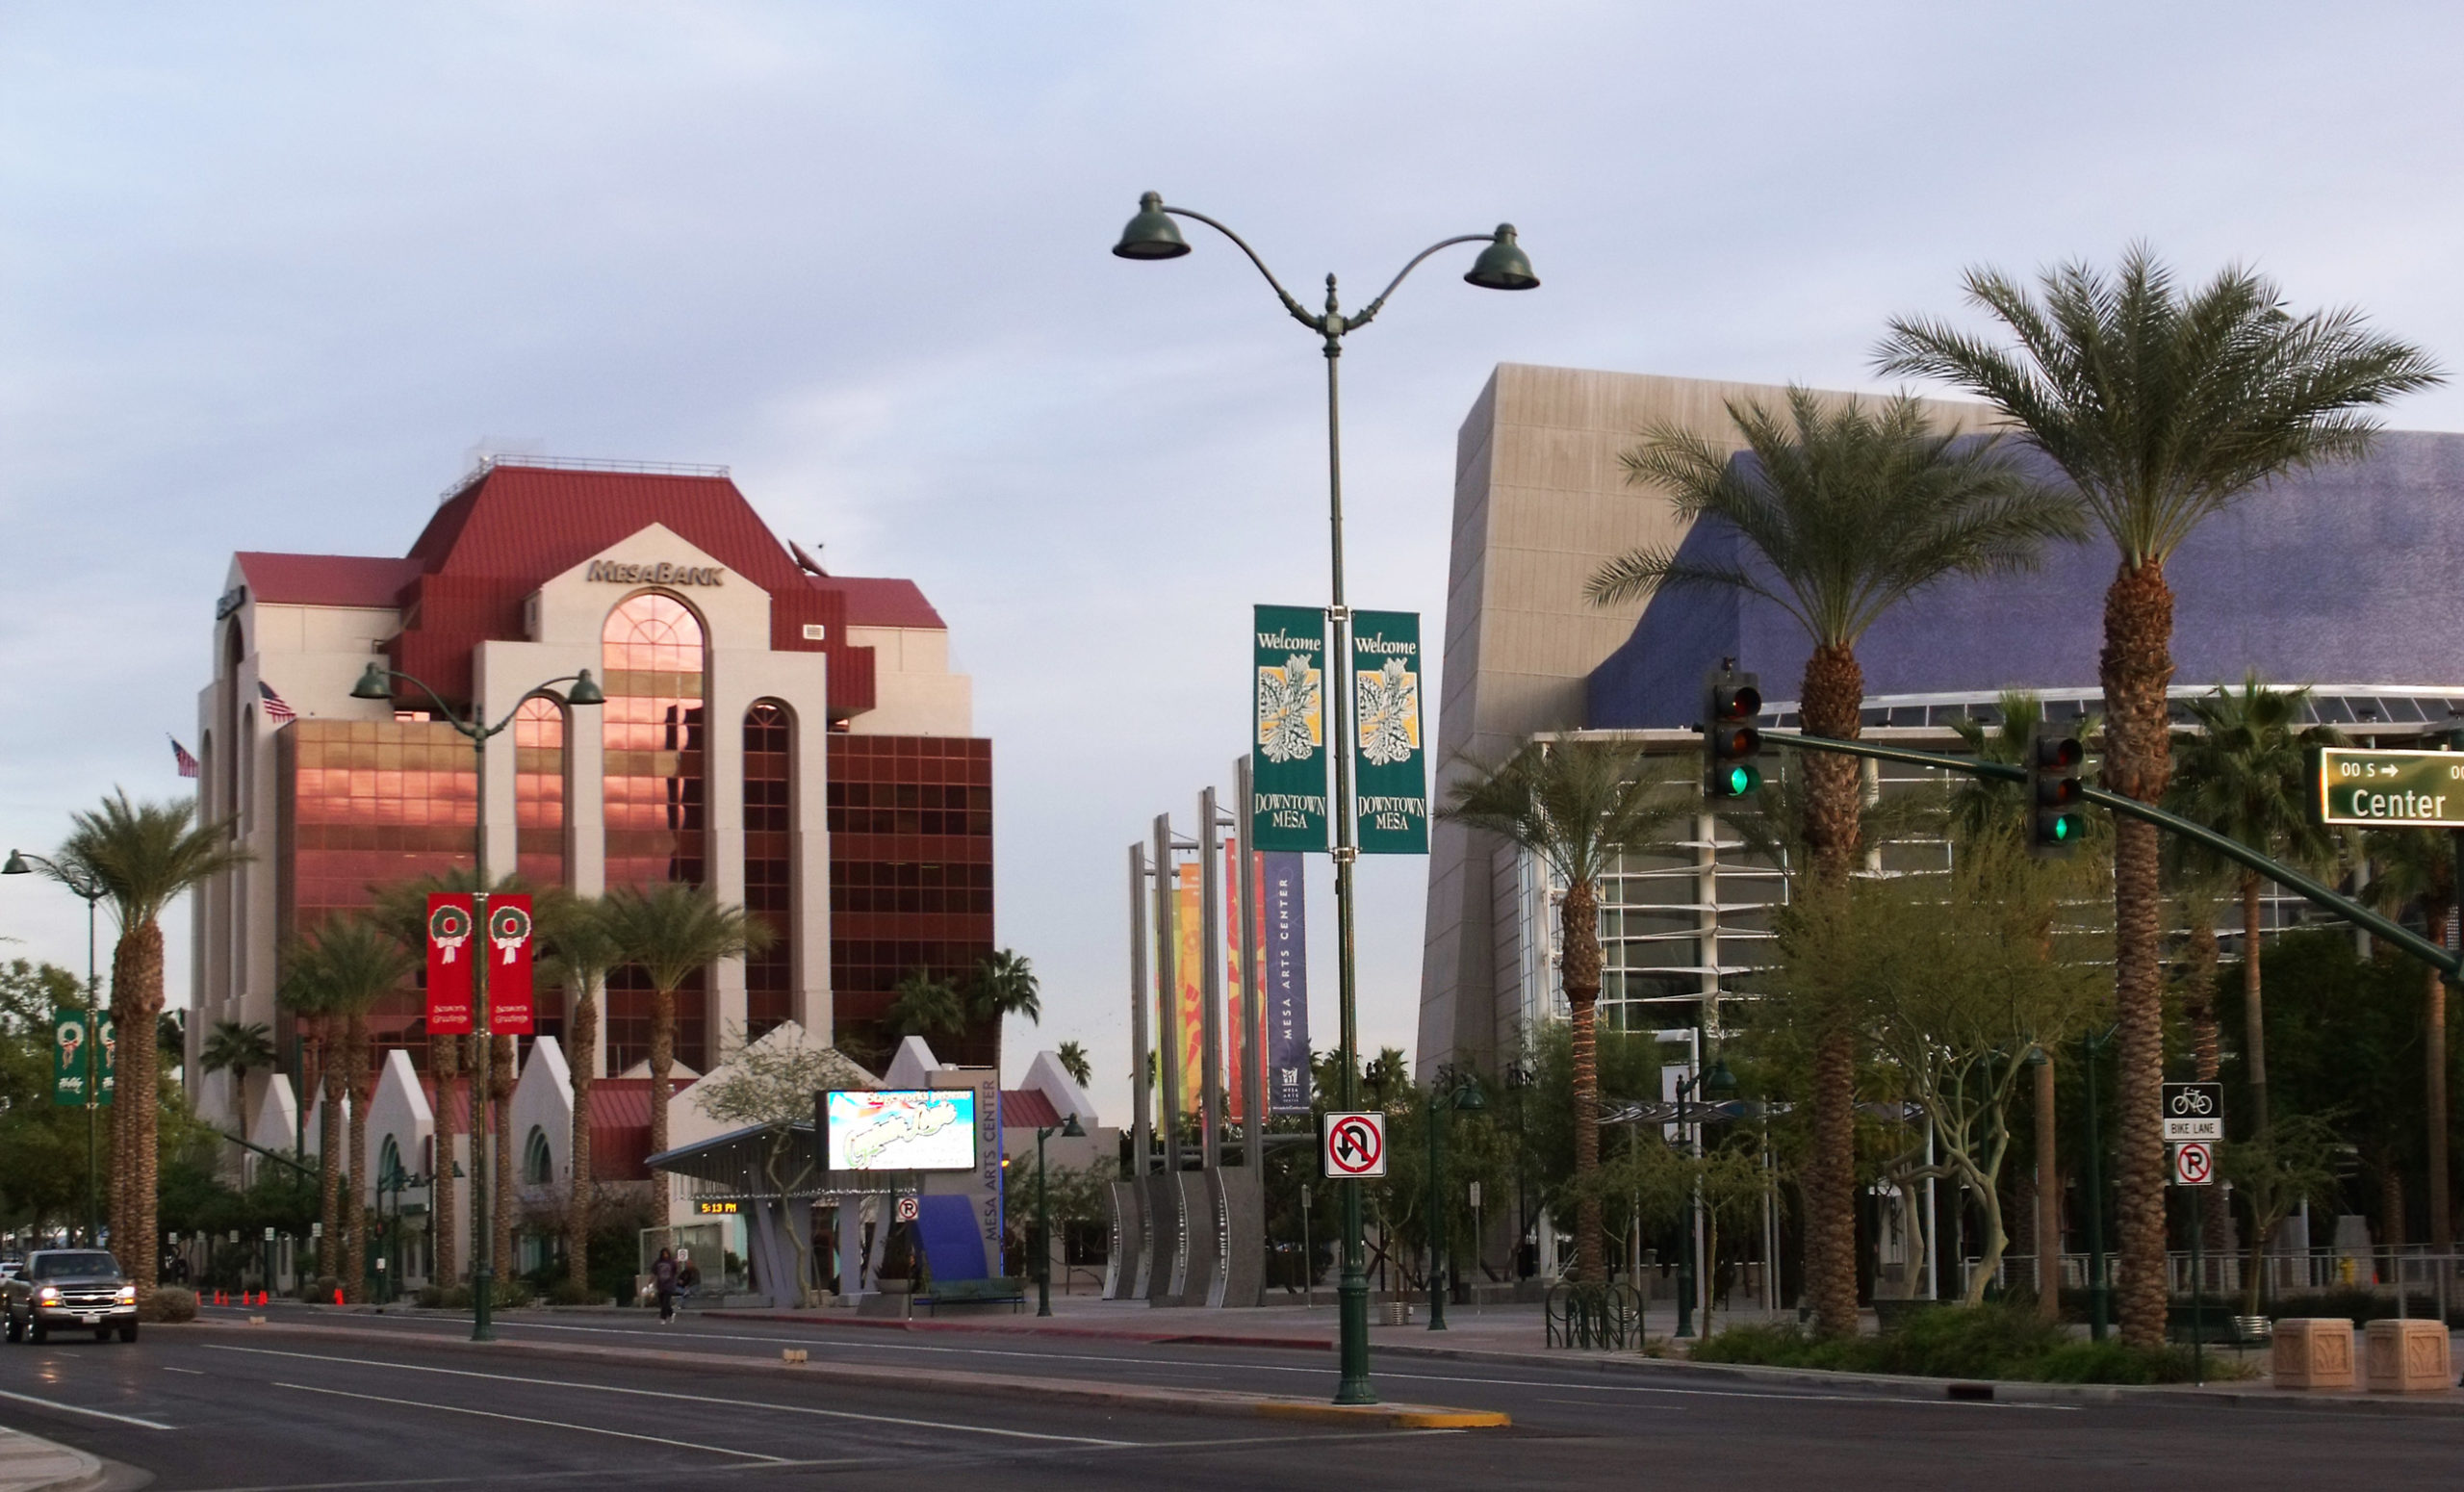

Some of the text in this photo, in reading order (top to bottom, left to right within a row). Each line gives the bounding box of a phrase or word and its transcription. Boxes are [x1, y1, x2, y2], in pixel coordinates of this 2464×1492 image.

[1257, 628, 1322, 652] Welcome
[1354, 631, 1417, 656] Welcome
[2367, 763, 2375, 777] S
[1255, 793, 1326, 817] DOWNTOWN
[1358, 795, 1425, 819] DOWNTOWN
[2352, 788, 2446, 818] Center
[1272, 810, 1308, 830] MESA
[1375, 812, 1409, 831] MESA
[1279, 879, 1293, 1040] MESA ARTS CENTER
[2171, 1123, 2214, 1134] BIKE LANE
[983, 1080, 997, 1241] MESA ARTS CENTER
[702, 1202, 737, 1213] 5:13 PM
